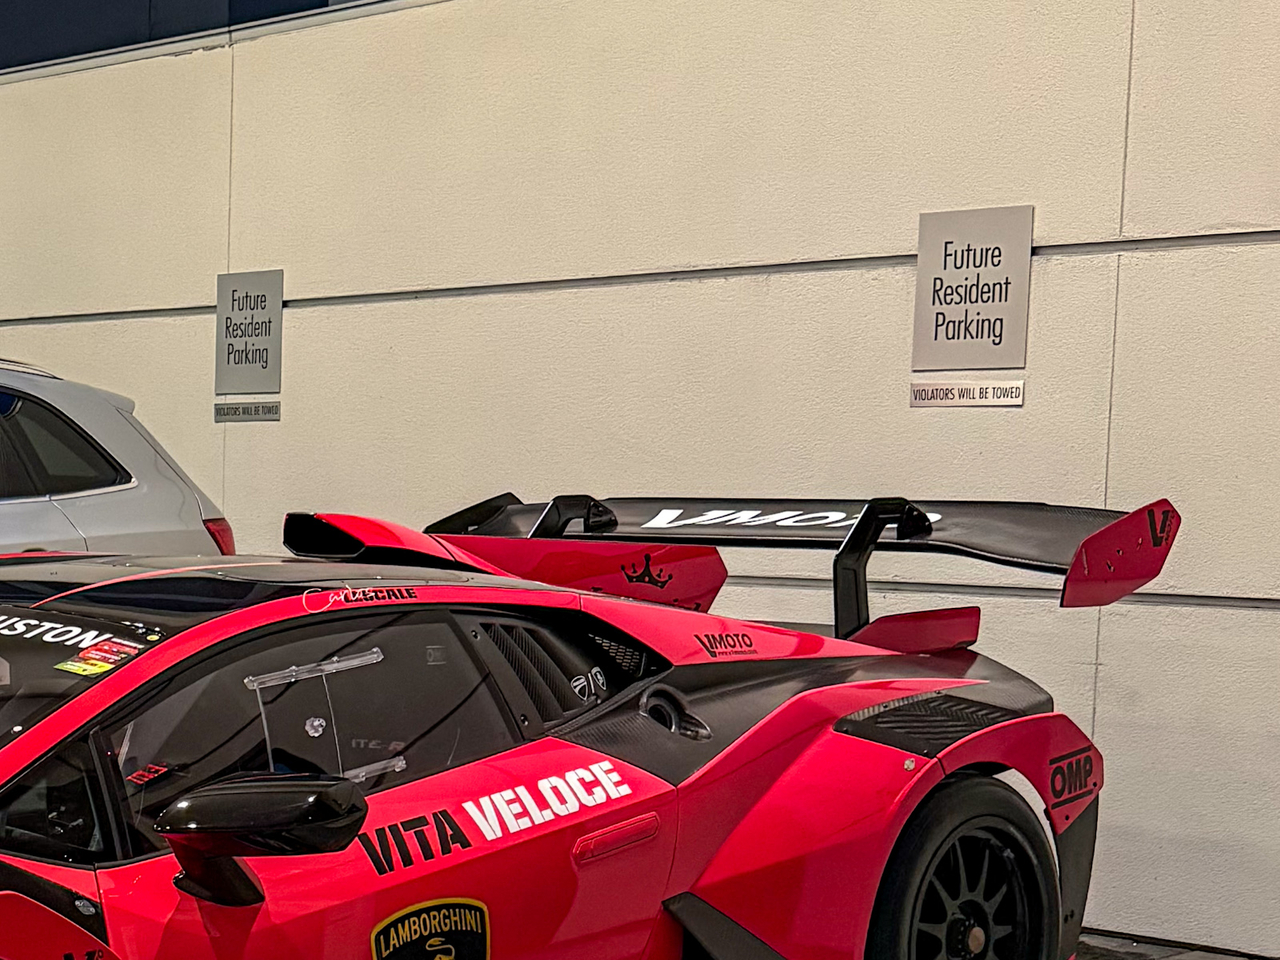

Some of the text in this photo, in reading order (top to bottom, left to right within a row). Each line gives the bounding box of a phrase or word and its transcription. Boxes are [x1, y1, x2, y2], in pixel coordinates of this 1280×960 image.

[943, 241, 1002, 271] Future
[231, 289, 267, 312] Future
[932, 273, 1012, 306] Resident
[225, 314, 272, 339] Resident
[934, 309, 1004, 346] Parking
[227, 341, 269, 370] Parking
[913, 386, 1021, 401] VIOLATORS WILL BE TOWED
[215, 405, 278, 417] VIOLATORS WILL BE TOWED
[1050, 754, 1093, 800] OMP
[358, 760, 633, 877] VITA VELOCE
[379, 907, 483, 959] LAMBORGHINI
